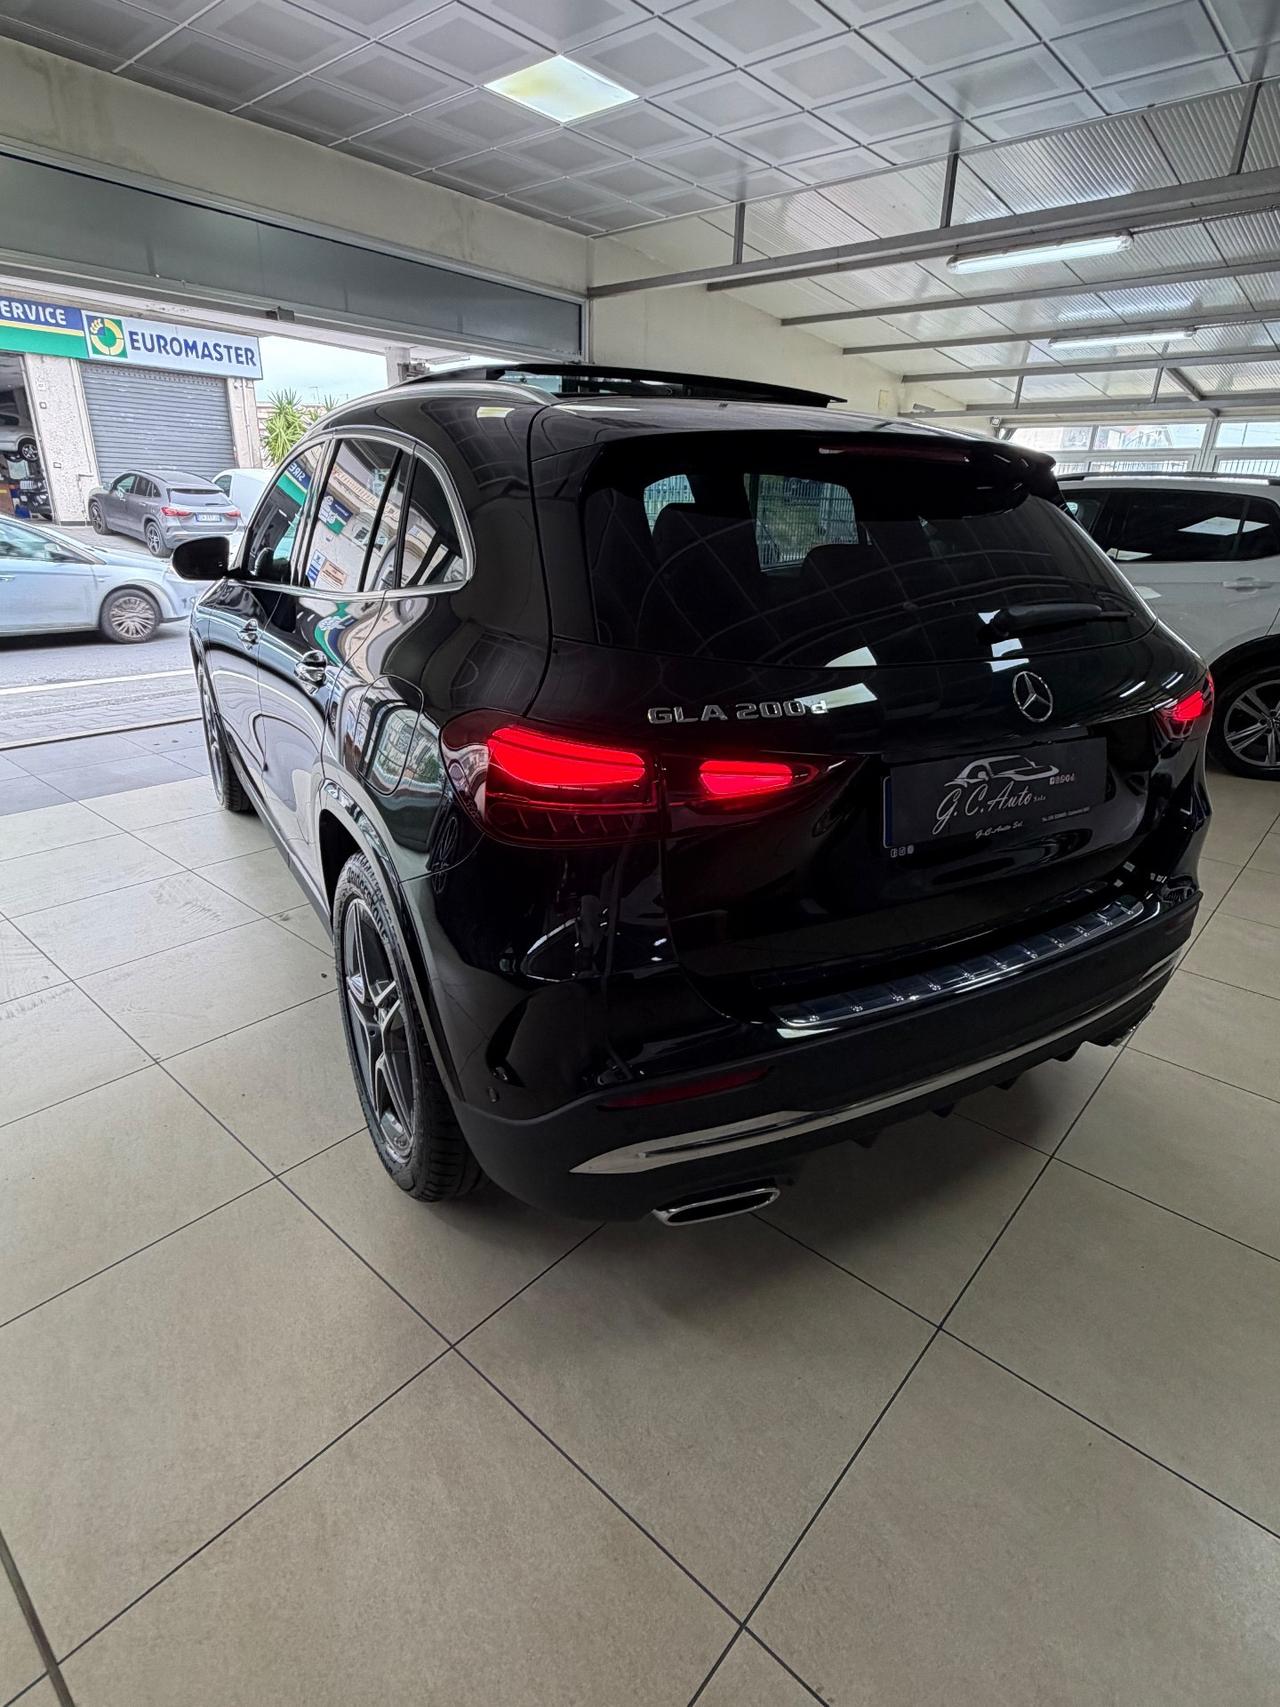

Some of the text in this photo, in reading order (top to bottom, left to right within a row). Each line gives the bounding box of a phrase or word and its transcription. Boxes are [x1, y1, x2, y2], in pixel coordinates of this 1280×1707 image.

[0, 300, 66, 325] ERVICE
[128, 330, 257, 367] EUROMASTER
[647, 700, 829, 724] GLA 200 d
